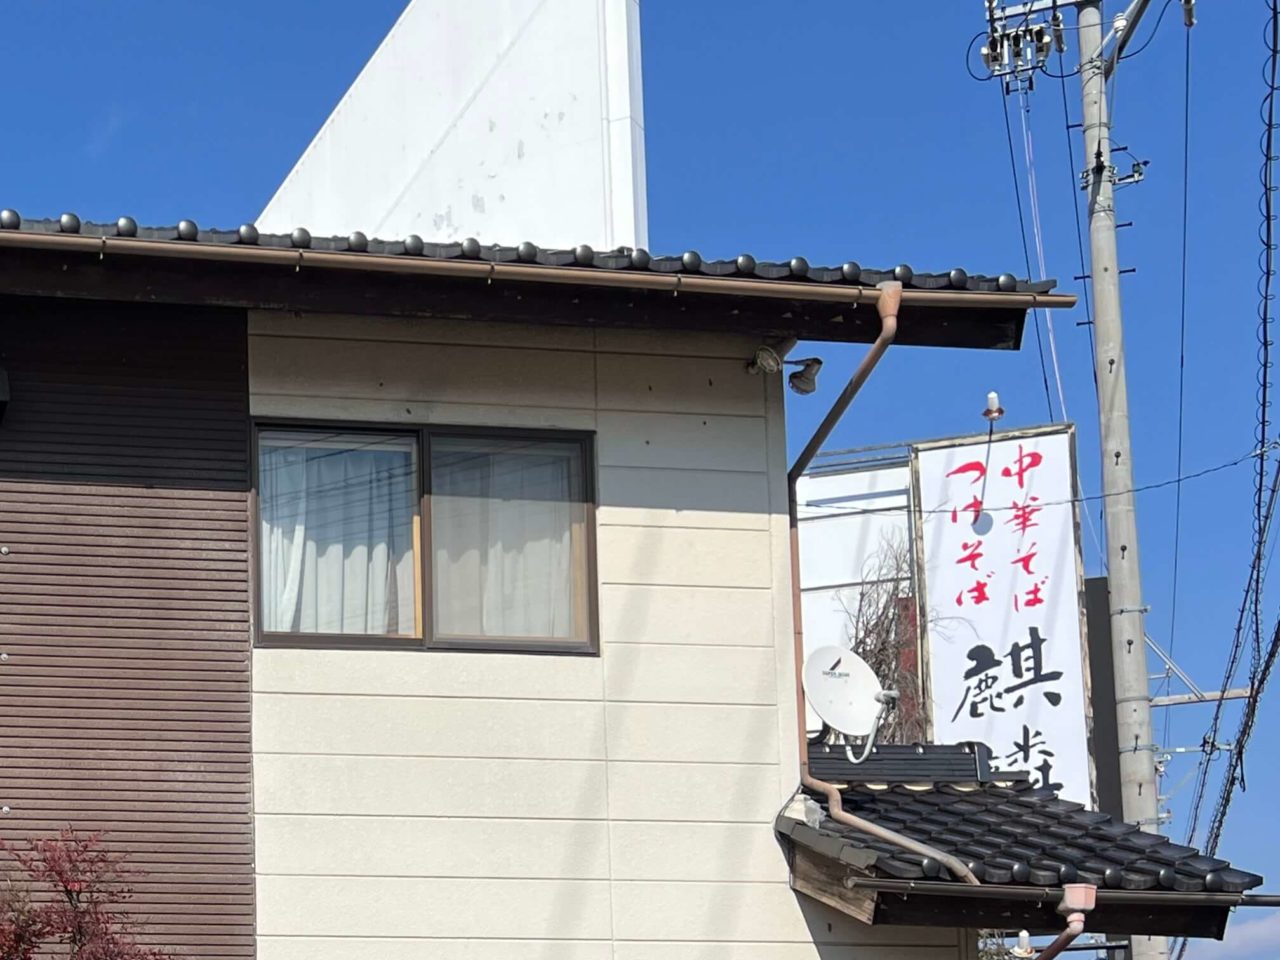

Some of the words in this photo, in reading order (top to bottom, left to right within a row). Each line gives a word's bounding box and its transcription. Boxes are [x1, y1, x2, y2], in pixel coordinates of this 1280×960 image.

[945, 460, 995, 608] つけそば
[1001, 444, 1049, 613] 中華そば
